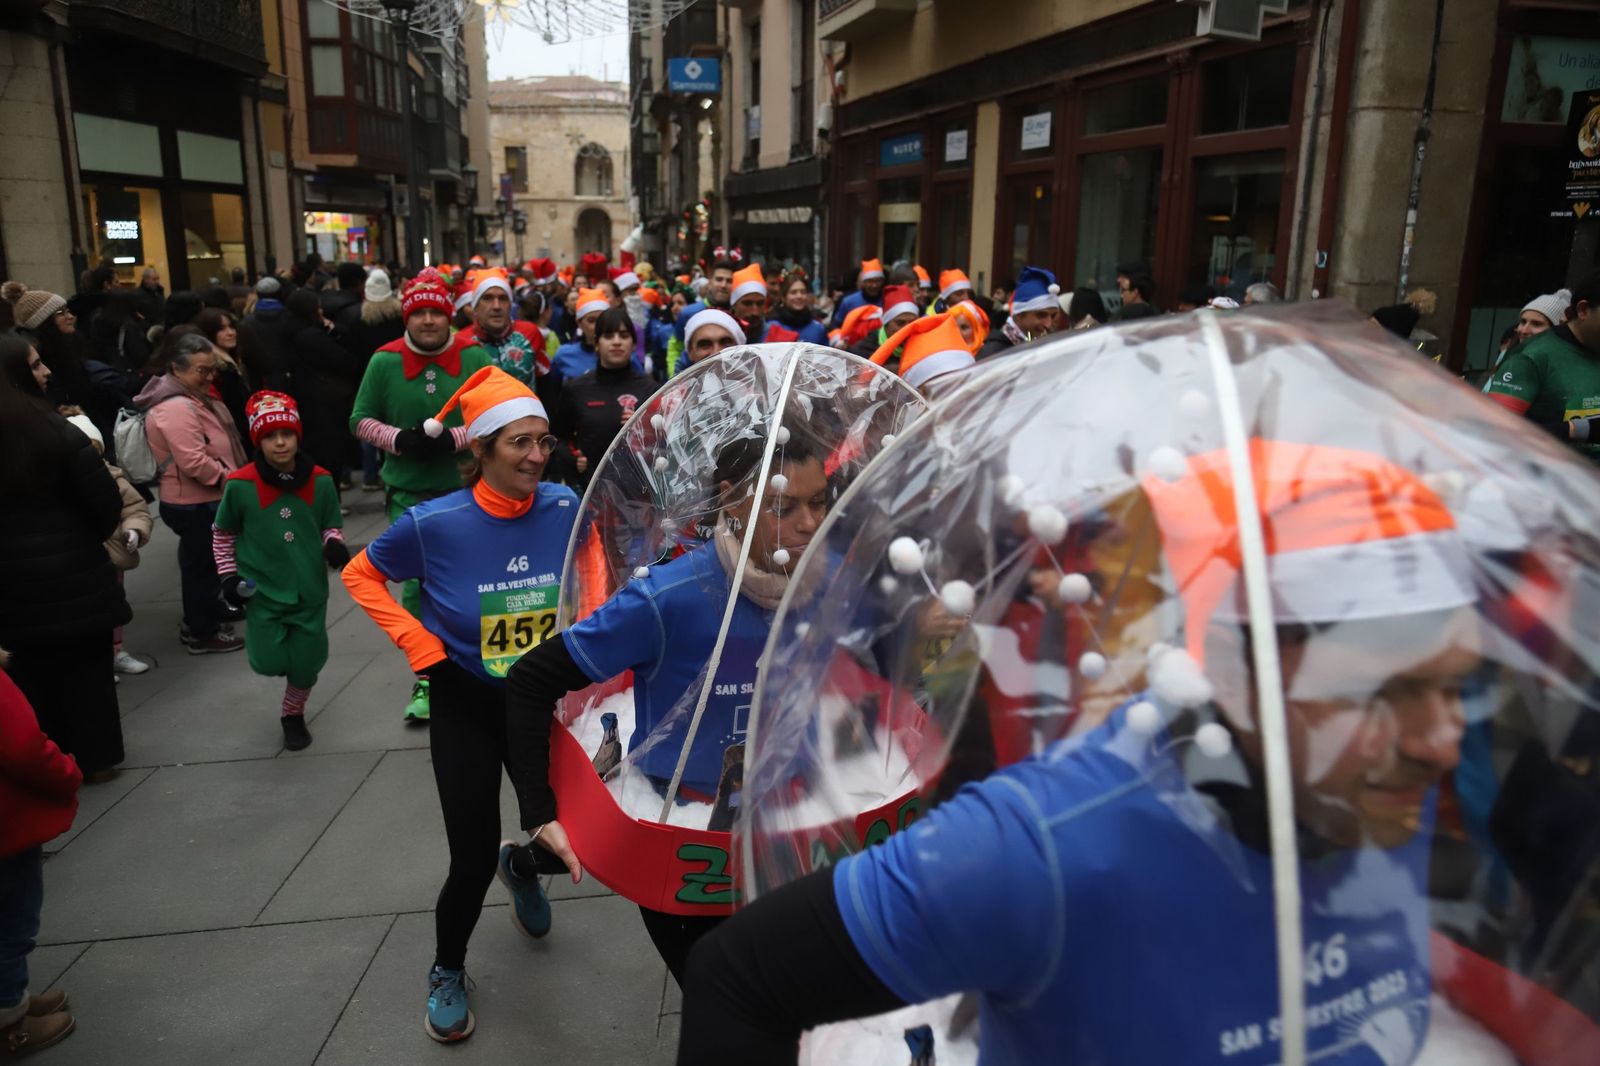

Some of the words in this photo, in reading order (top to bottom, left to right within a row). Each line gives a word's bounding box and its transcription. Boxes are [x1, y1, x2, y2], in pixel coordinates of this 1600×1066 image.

[1559, 52, 1576, 68] Un
[507, 555, 529, 573] 46
[478, 583, 494, 593] SAN
[538, 573, 555, 583] 2025
[524, 598, 547, 606] RURAL
[487, 613, 556, 651] 452
[715, 684, 738, 695] SAN
[1220, 1023, 1262, 1056] SAN
